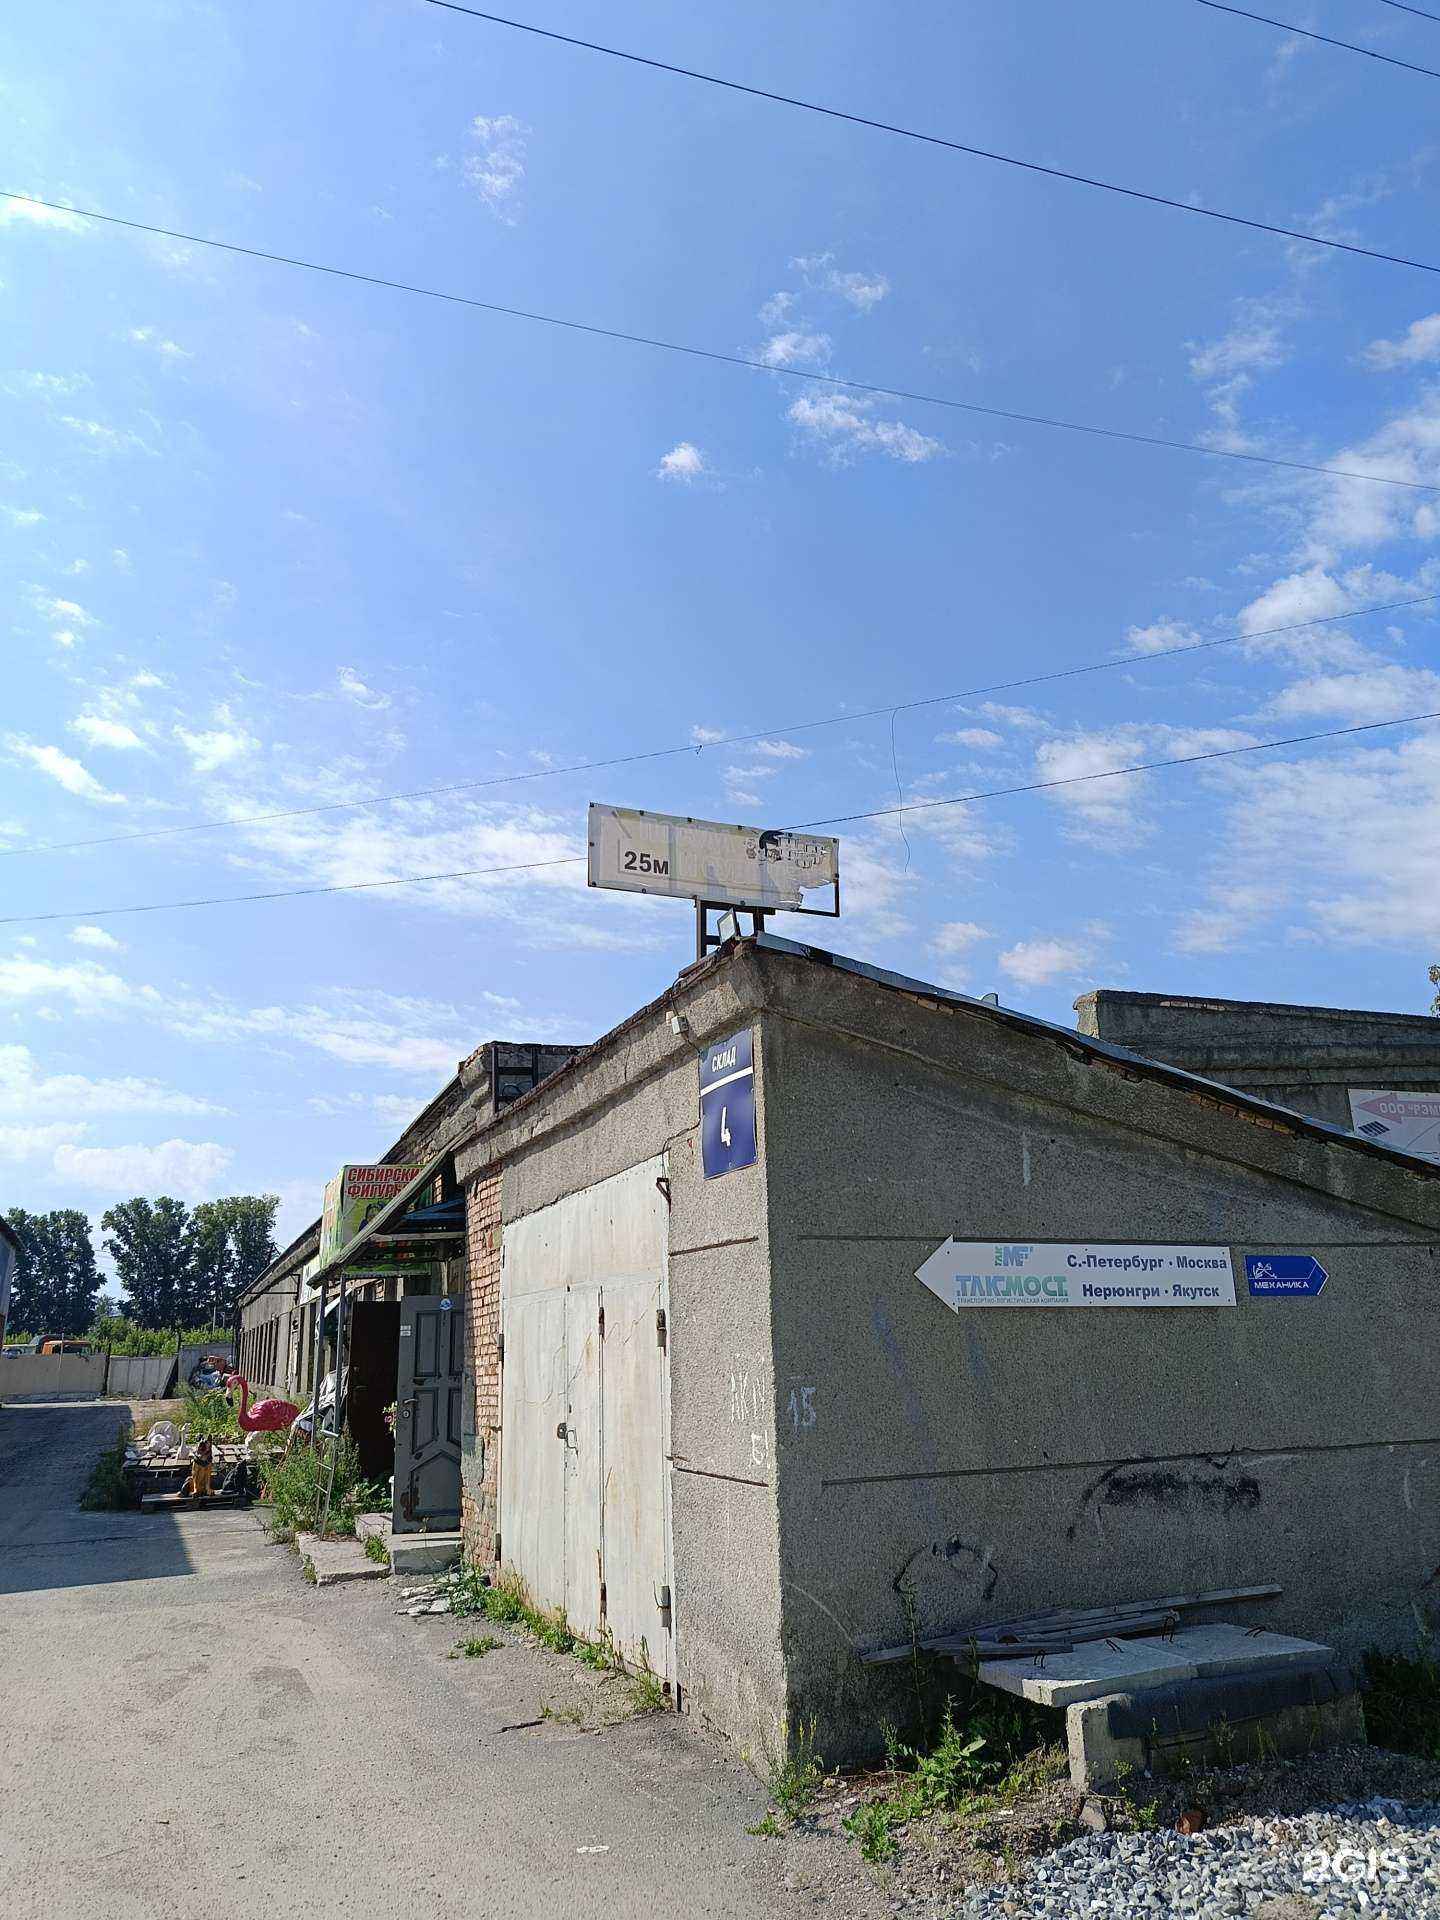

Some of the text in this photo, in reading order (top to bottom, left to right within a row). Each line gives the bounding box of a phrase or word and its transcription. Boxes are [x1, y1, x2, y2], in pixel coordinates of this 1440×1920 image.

[711, 1046, 737, 1073] СКЛАД
[720, 1106, 732, 1147] 4
[347, 1168, 423, 1182] СИБИРСКИ
[1067, 1254, 1227, 1271] С.-Петербург Москва
[1082, 1283, 1220, 1300] Нерюнгри Якутск
[1254, 1281, 1310, 1289] МЕХАНИКА
